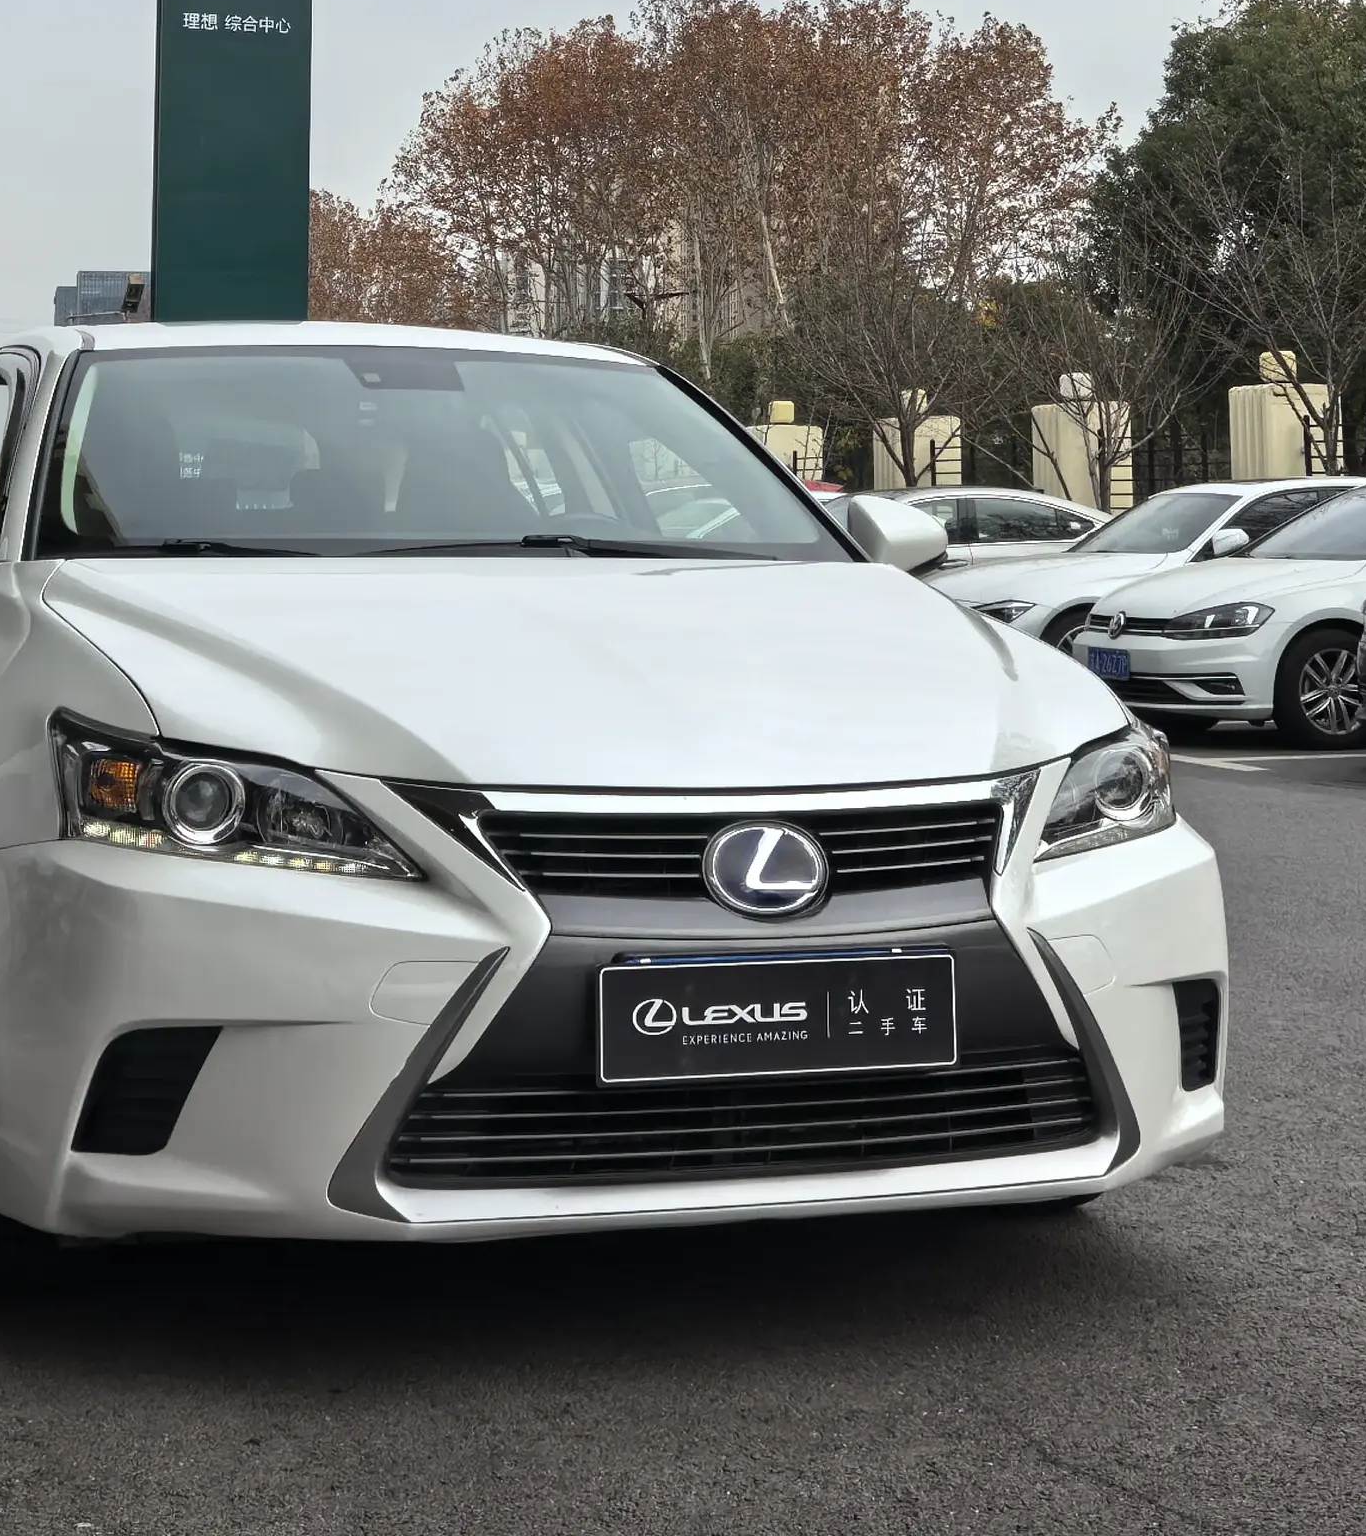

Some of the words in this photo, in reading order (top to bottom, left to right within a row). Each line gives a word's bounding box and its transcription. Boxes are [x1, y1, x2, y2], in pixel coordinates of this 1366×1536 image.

[182, 12, 218, 31] 理想
[224, 14, 291, 35] 综合中心
[682, 1002, 808, 1026] LEXUS
[682, 1032, 752, 1046] EXPERIENCE
[756, 1030, 809, 1042] AMAZING
